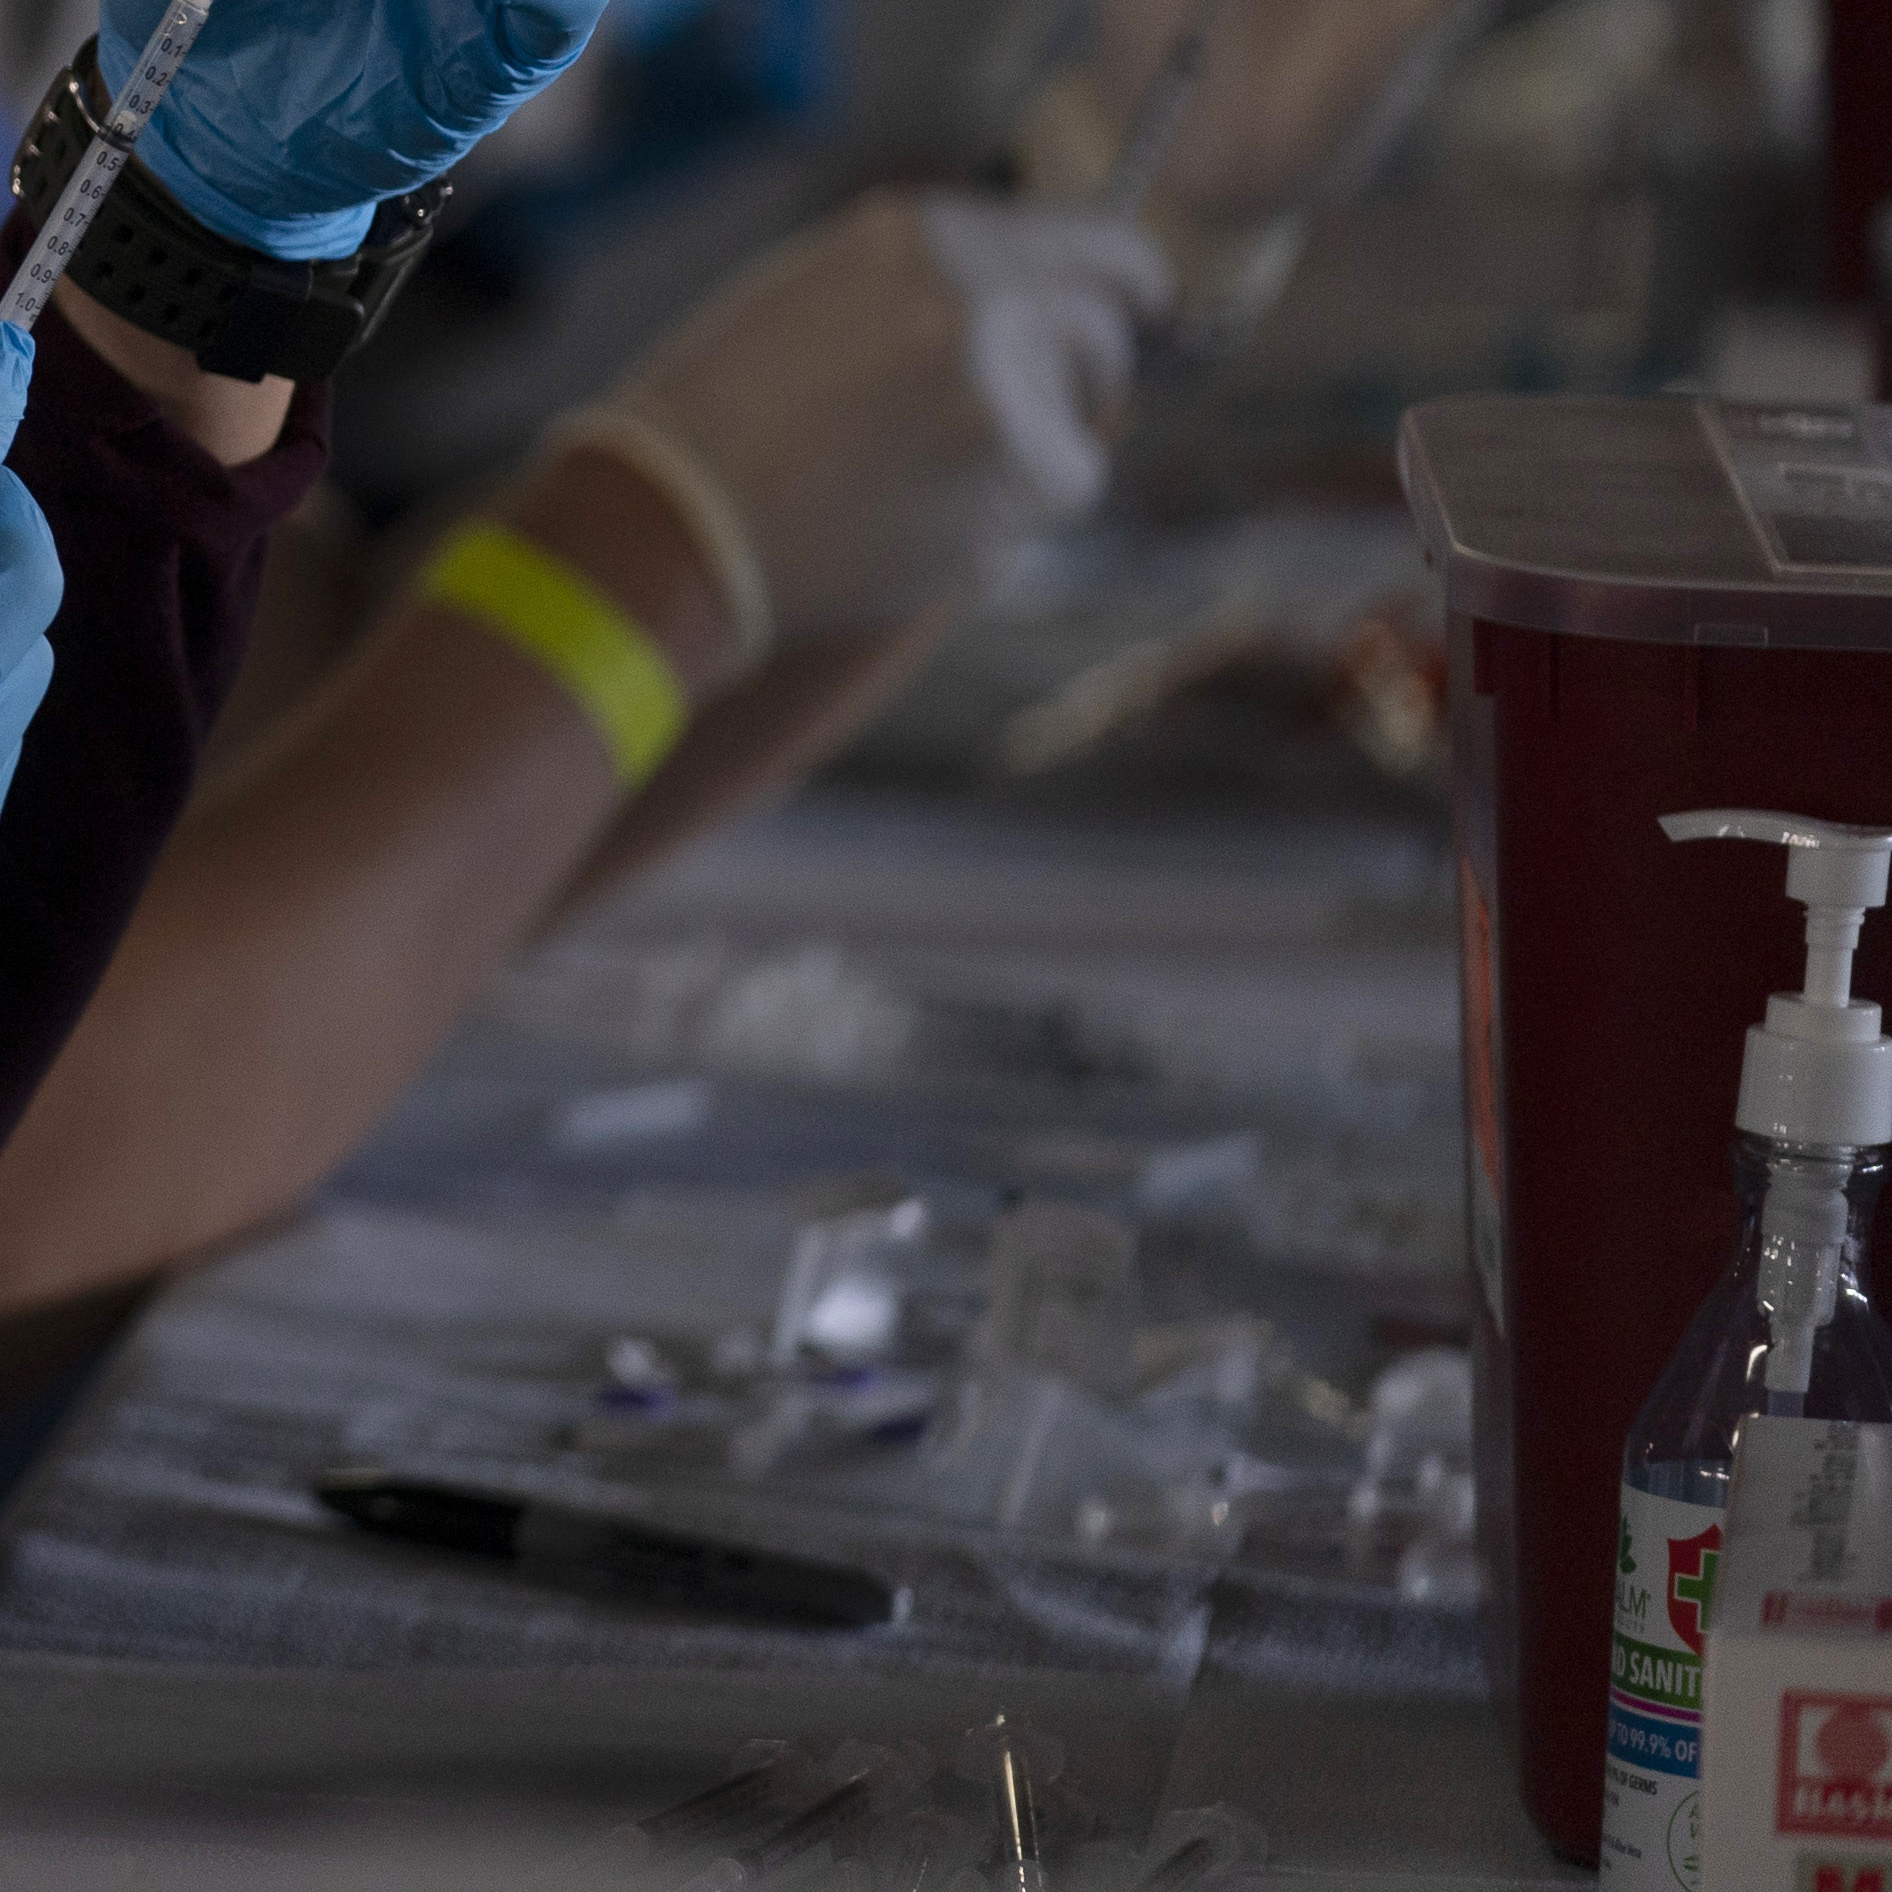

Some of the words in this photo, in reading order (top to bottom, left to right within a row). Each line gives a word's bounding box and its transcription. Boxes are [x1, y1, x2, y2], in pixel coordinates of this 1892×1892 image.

[161, 37, 183, 58] 0.1
[145, 65, 168, 87] 0.2
[129, 94, 151, 115] 0.3
[96, 151, 118, 172] 0.5
[80, 179, 102, 200] 0.6
[63, 207, 87, 227] 0.7
[46, 235, 69, 256] 0.8
[30, 263, 53, 284] 0.9
[15, 292, 36, 312] 1.0
[1630, 1729, 1672, 1759] 99.9%
[1674, 1739, 1697, 1763] OF
[1629, 1774, 1658, 1796] GERMS
